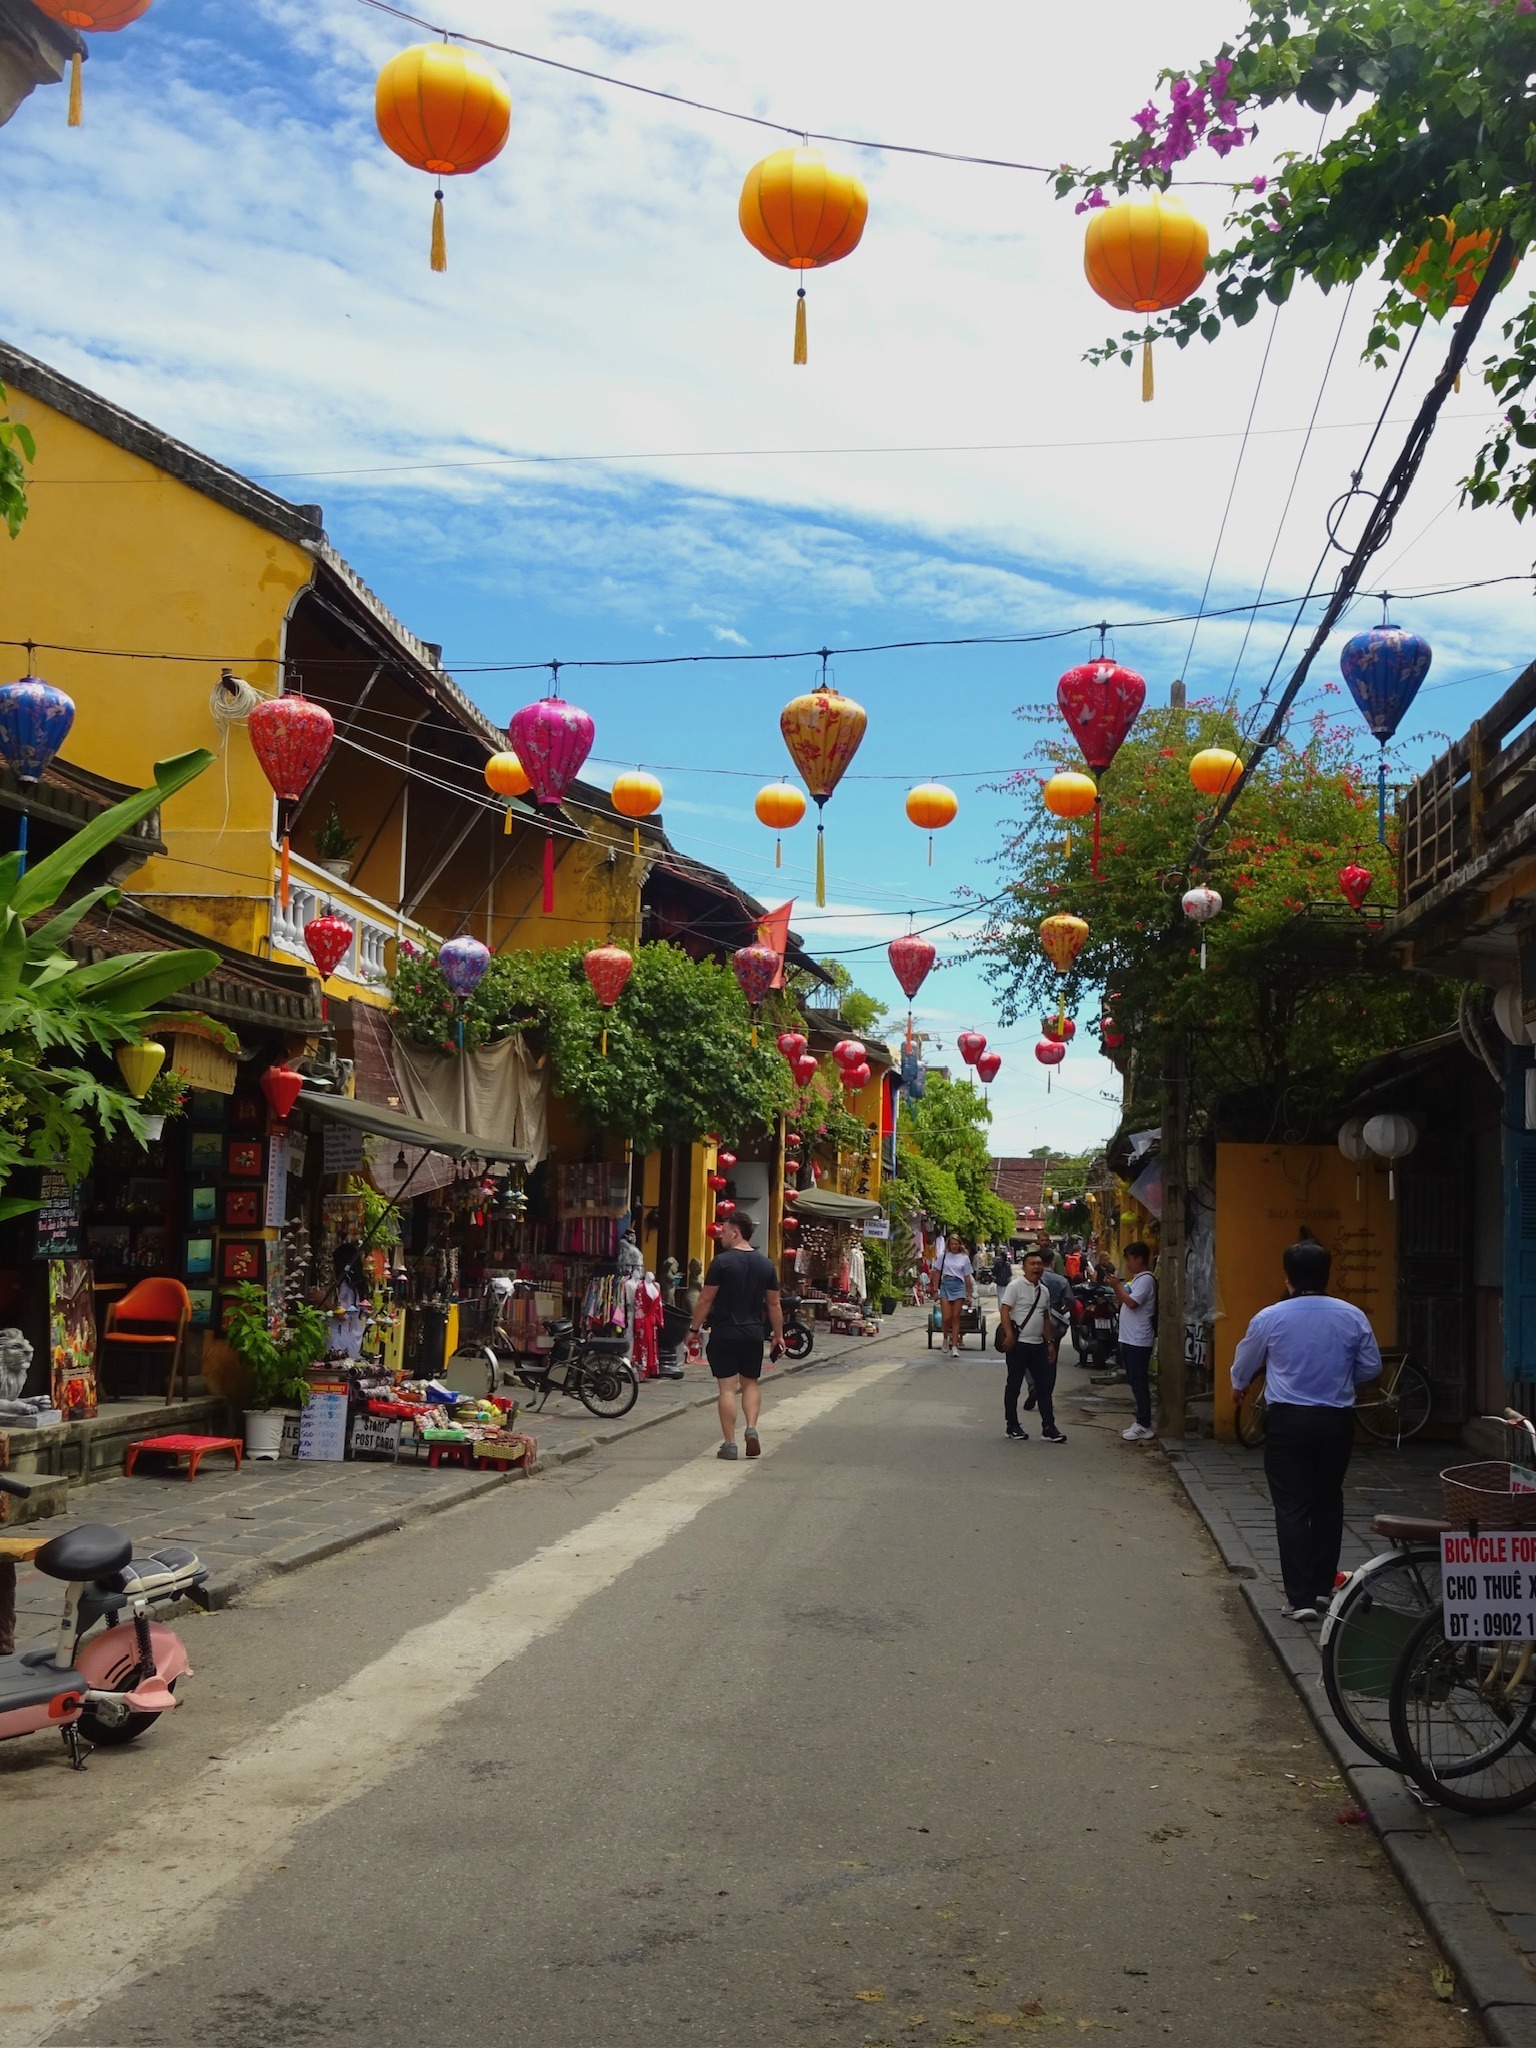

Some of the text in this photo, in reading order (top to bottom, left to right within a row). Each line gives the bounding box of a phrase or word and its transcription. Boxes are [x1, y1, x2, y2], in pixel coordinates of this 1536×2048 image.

[364, 1420, 390, 1434] STAMP
[355, 1433, 373, 1447] POST
[375, 1437, 394, 1450] CARD
[1445, 1537, 1507, 1563] BICYCLE
[1446, 1575, 1477, 1600] CHO
[1483, 1570, 1522, 1600] THUÊ
[1483, 1613, 1522, 1636] 0902
